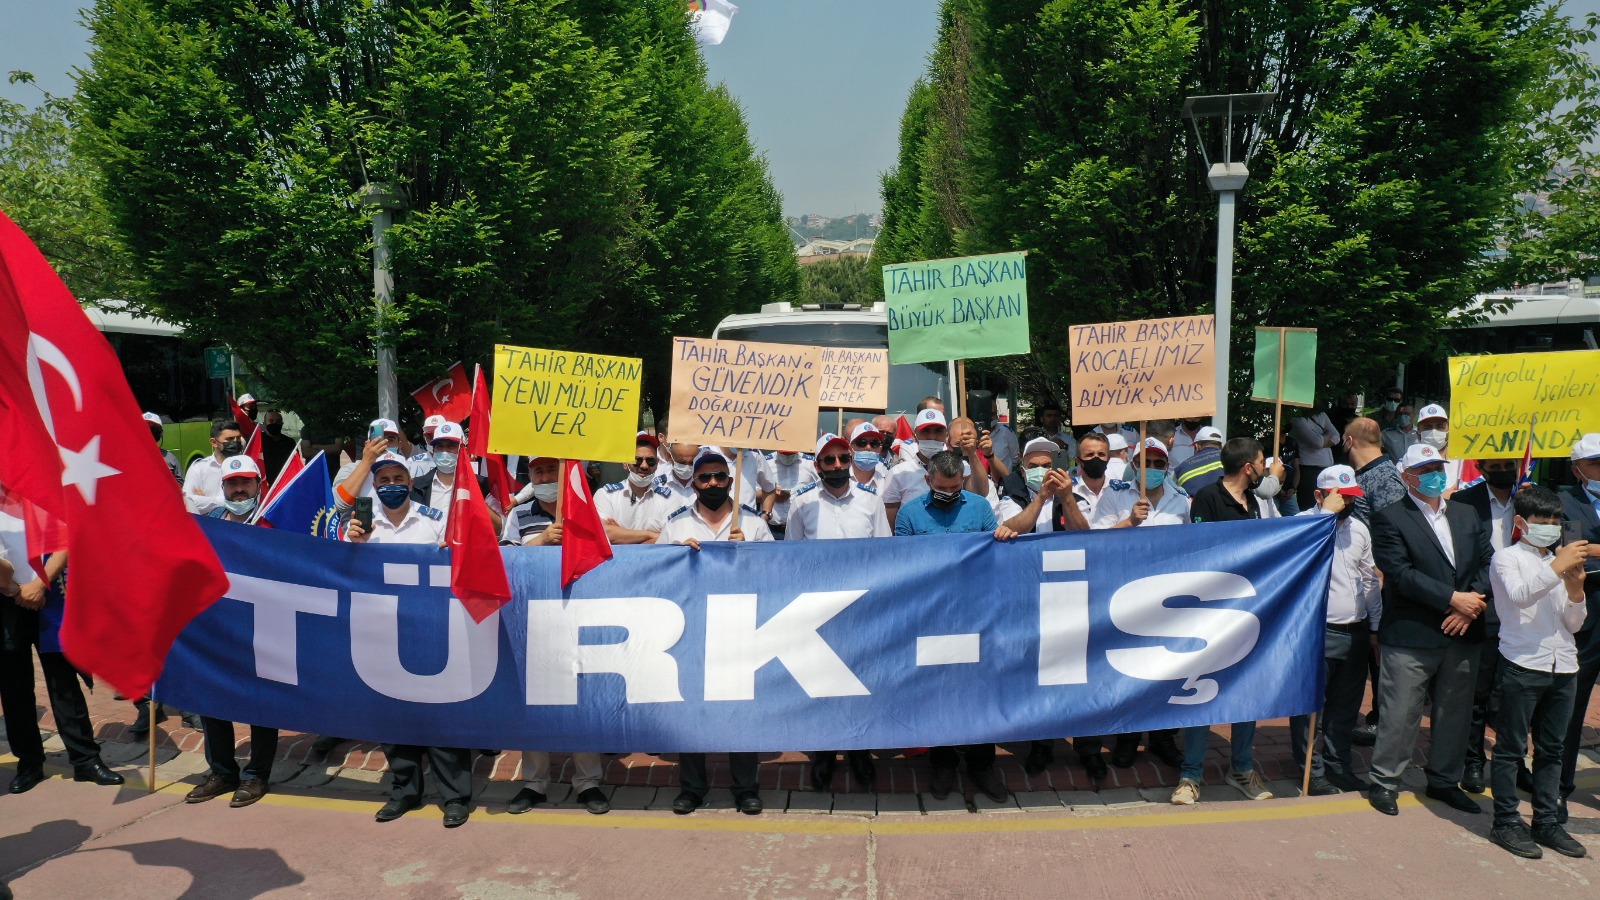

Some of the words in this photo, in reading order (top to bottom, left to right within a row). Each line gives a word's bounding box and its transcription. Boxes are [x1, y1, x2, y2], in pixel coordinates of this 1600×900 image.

[885, 265, 946, 294] TAHİR
[951, 258, 1026, 288] BAŞKAN
[888, 305, 945, 331] BÜYÜK
[949, 293, 1022, 325] BAŞKAN
[1073, 323, 1128, 346] TAHİR
[1131, 318, 1214, 342] BAŞKAN
[501, 348, 567, 374] TAHİR
[571, 355, 641, 381] BAŞKAN
[677, 339, 730, 365] TAHİR
[838, 349, 882, 365] BAŞKAN
[1075, 338, 1205, 373] KOCAELİMİZ
[692, 366, 814, 398] GÜVENDİK
[823, 364, 865, 375] DEMEK
[1456, 358, 1536, 397] Plajyolu
[499, 375, 552, 406] YENİ
[554, 380, 629, 412] MÜJDE
[688, 394, 792, 417] DOĞRUSUNU
[820, 391, 866, 403] DEMEK
[1076, 383, 1144, 408] BÜYÜK
[1149, 383, 1204, 407] ŞANS
[533, 410, 587, 437] VER
[697, 413, 786, 442] YAPTIK
[1453, 401, 1582, 430] Sendikasının
[1462, 428, 1584, 454] YANINDA
